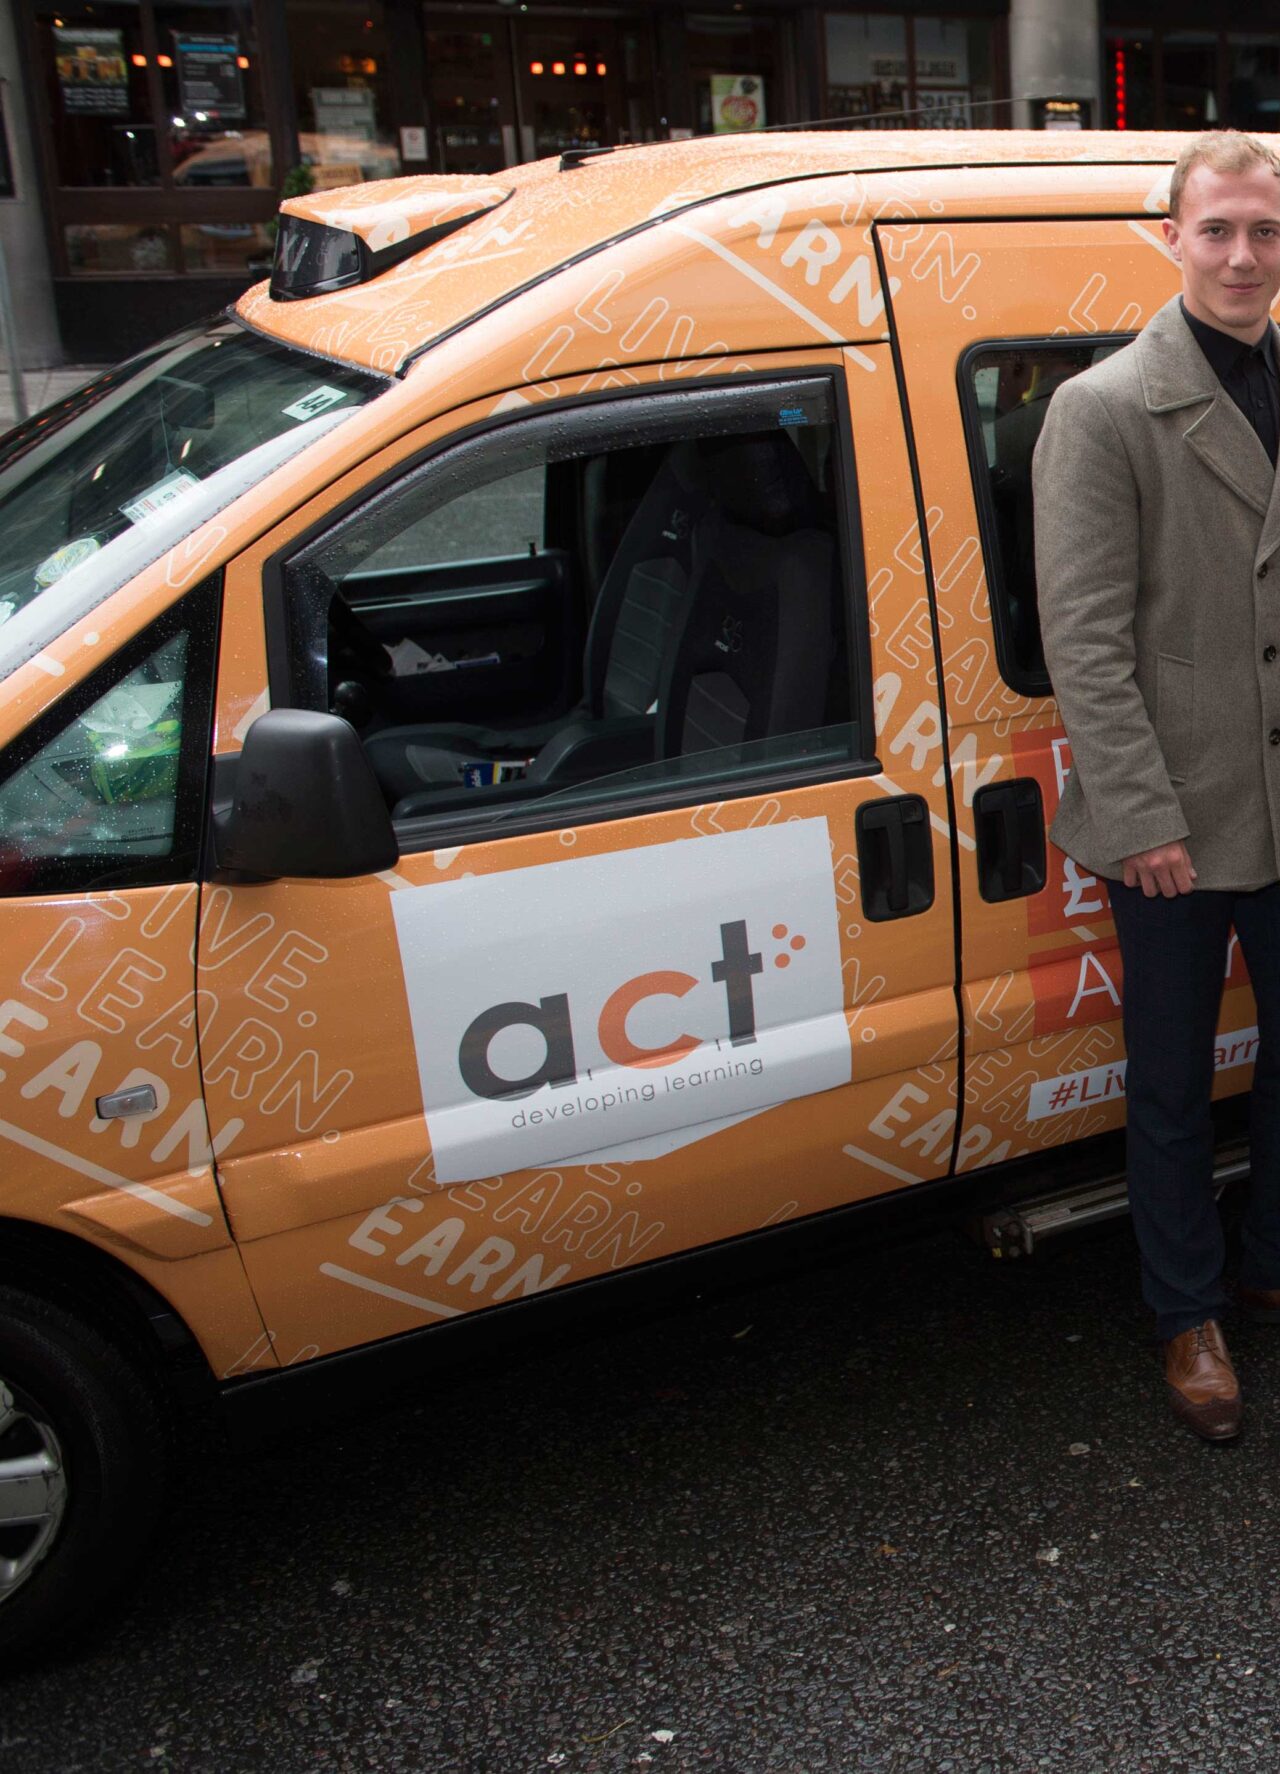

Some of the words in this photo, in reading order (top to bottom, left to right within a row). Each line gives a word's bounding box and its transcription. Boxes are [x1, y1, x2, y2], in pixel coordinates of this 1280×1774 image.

[21, 916, 354, 1144] LEARN.
[511, 1081, 656, 1129] developing
[664, 1054, 764, 1093] learning
